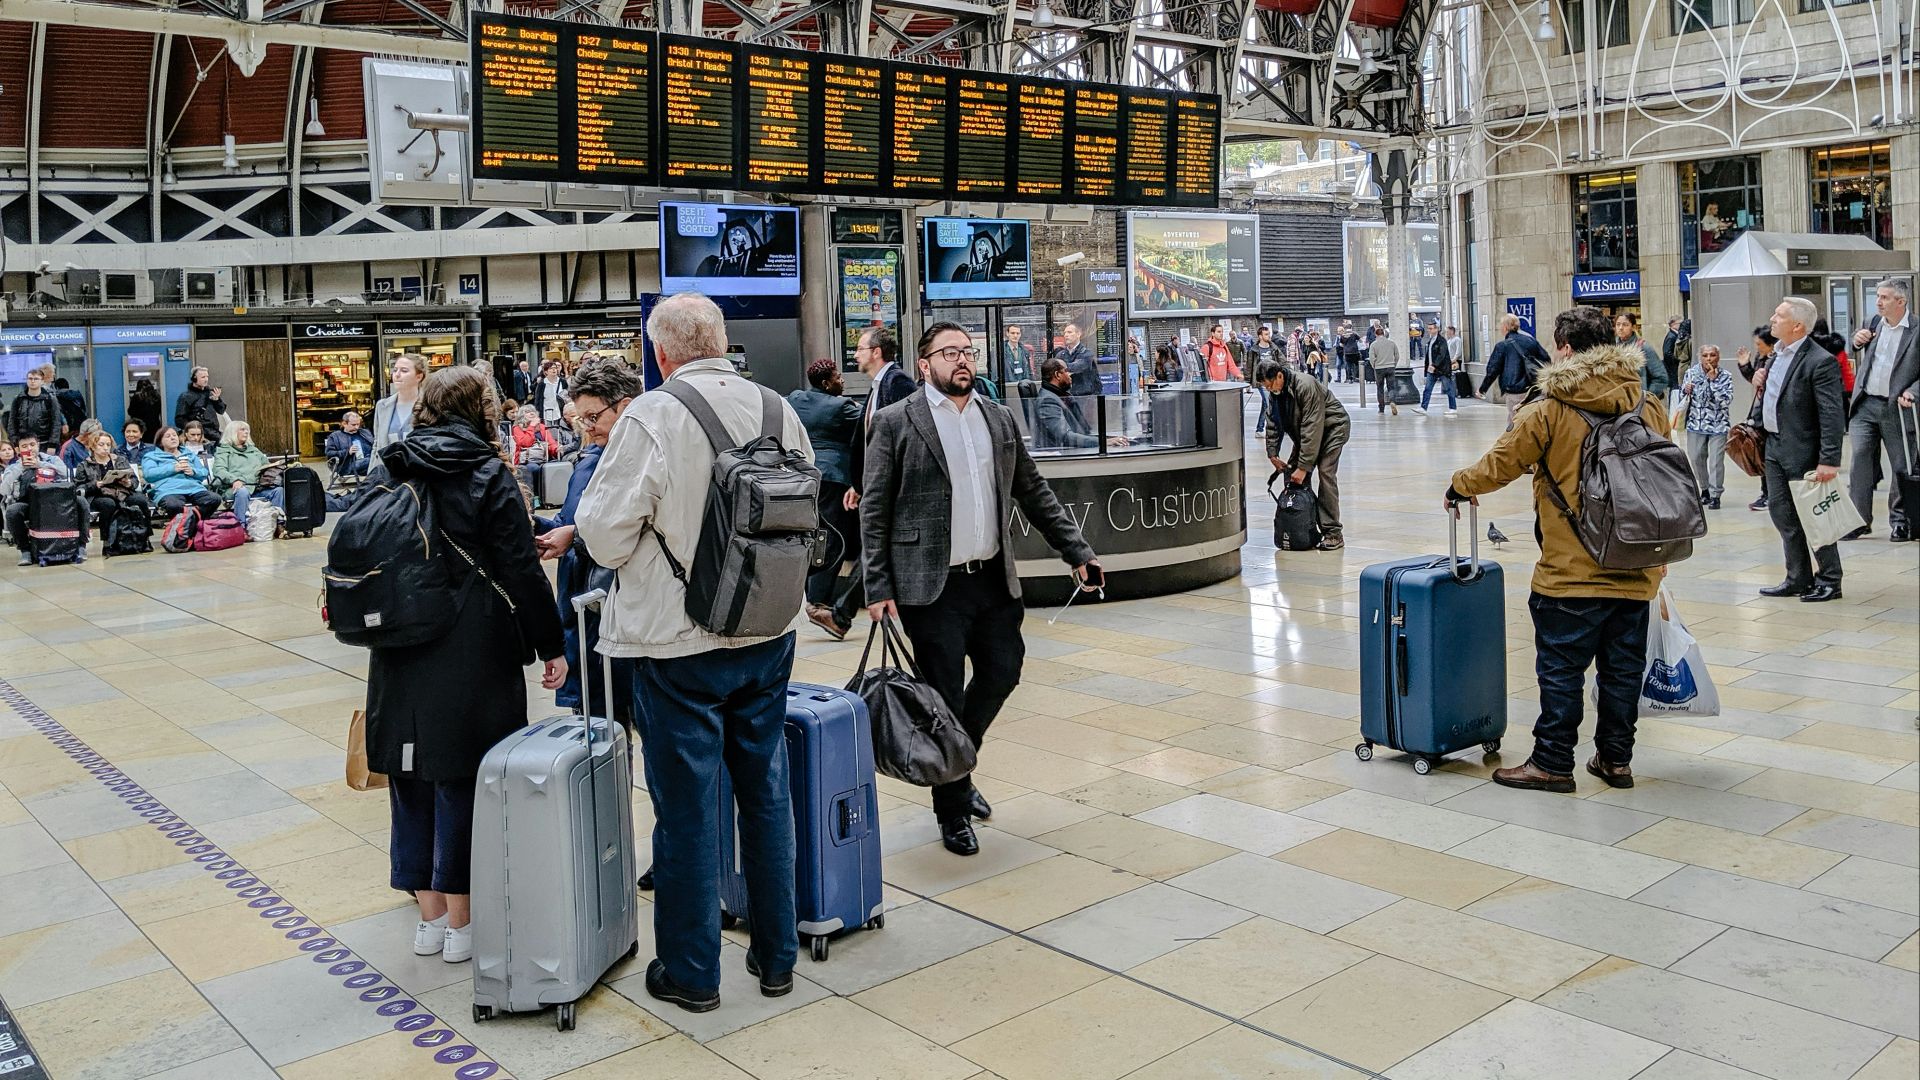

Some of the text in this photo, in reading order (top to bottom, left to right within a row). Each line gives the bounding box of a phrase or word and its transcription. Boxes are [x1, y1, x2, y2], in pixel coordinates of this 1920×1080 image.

[482, 25, 557, 42] 13:22 Boarding
[482, 40, 538, 52] Worcester Shrub
[578, 36, 648, 52] 13:27 Boarding
[577, 48, 608, 60] Cholsey
[669, 46, 732, 61] 13:30 Preparing
[484, 62, 556, 74] platform, passengers
[668, 58, 693, 68] Bristol
[704, 62, 725, 71] Meads
[751, 56, 808, 70] 13:33 Pls wait
[499, 72, 532, 80] Charlbury
[750, 67, 801, 80] Heathrow T234
[826, 64, 844, 73] 13:36
[856, 68, 865, 76] Pls
[599, 73, 628, 81] Broadway
[826, 75, 874, 88] Cheltenham Spa
[896, 72, 912, 81] 13:42
[895, 82, 920, 92] Twyford
[961, 80, 976, 88] 13:45
[1021, 85, 1035, 93] 13:47
[960, 90, 983, 99] Swansea
[1077, 90, 1090, 98] 13:25
[1076, 100, 1099, 108] Heathrow
[680, 216, 696, 224] SAY
[680, 225, 716, 233] SORTED.
[845, 265, 894, 278] escape
[1090, 272, 1121, 283] Paddington
[378, 282, 391, 293] 12
[462, 278, 477, 290] 14
[1096, 284, 1116, 294] Station
[1577, 278, 1637, 293] WHSmith
[846, 290, 870, 302] YOUR
[1510, 304, 1533, 316] WH
[1649, 702, 1665, 710] Join
